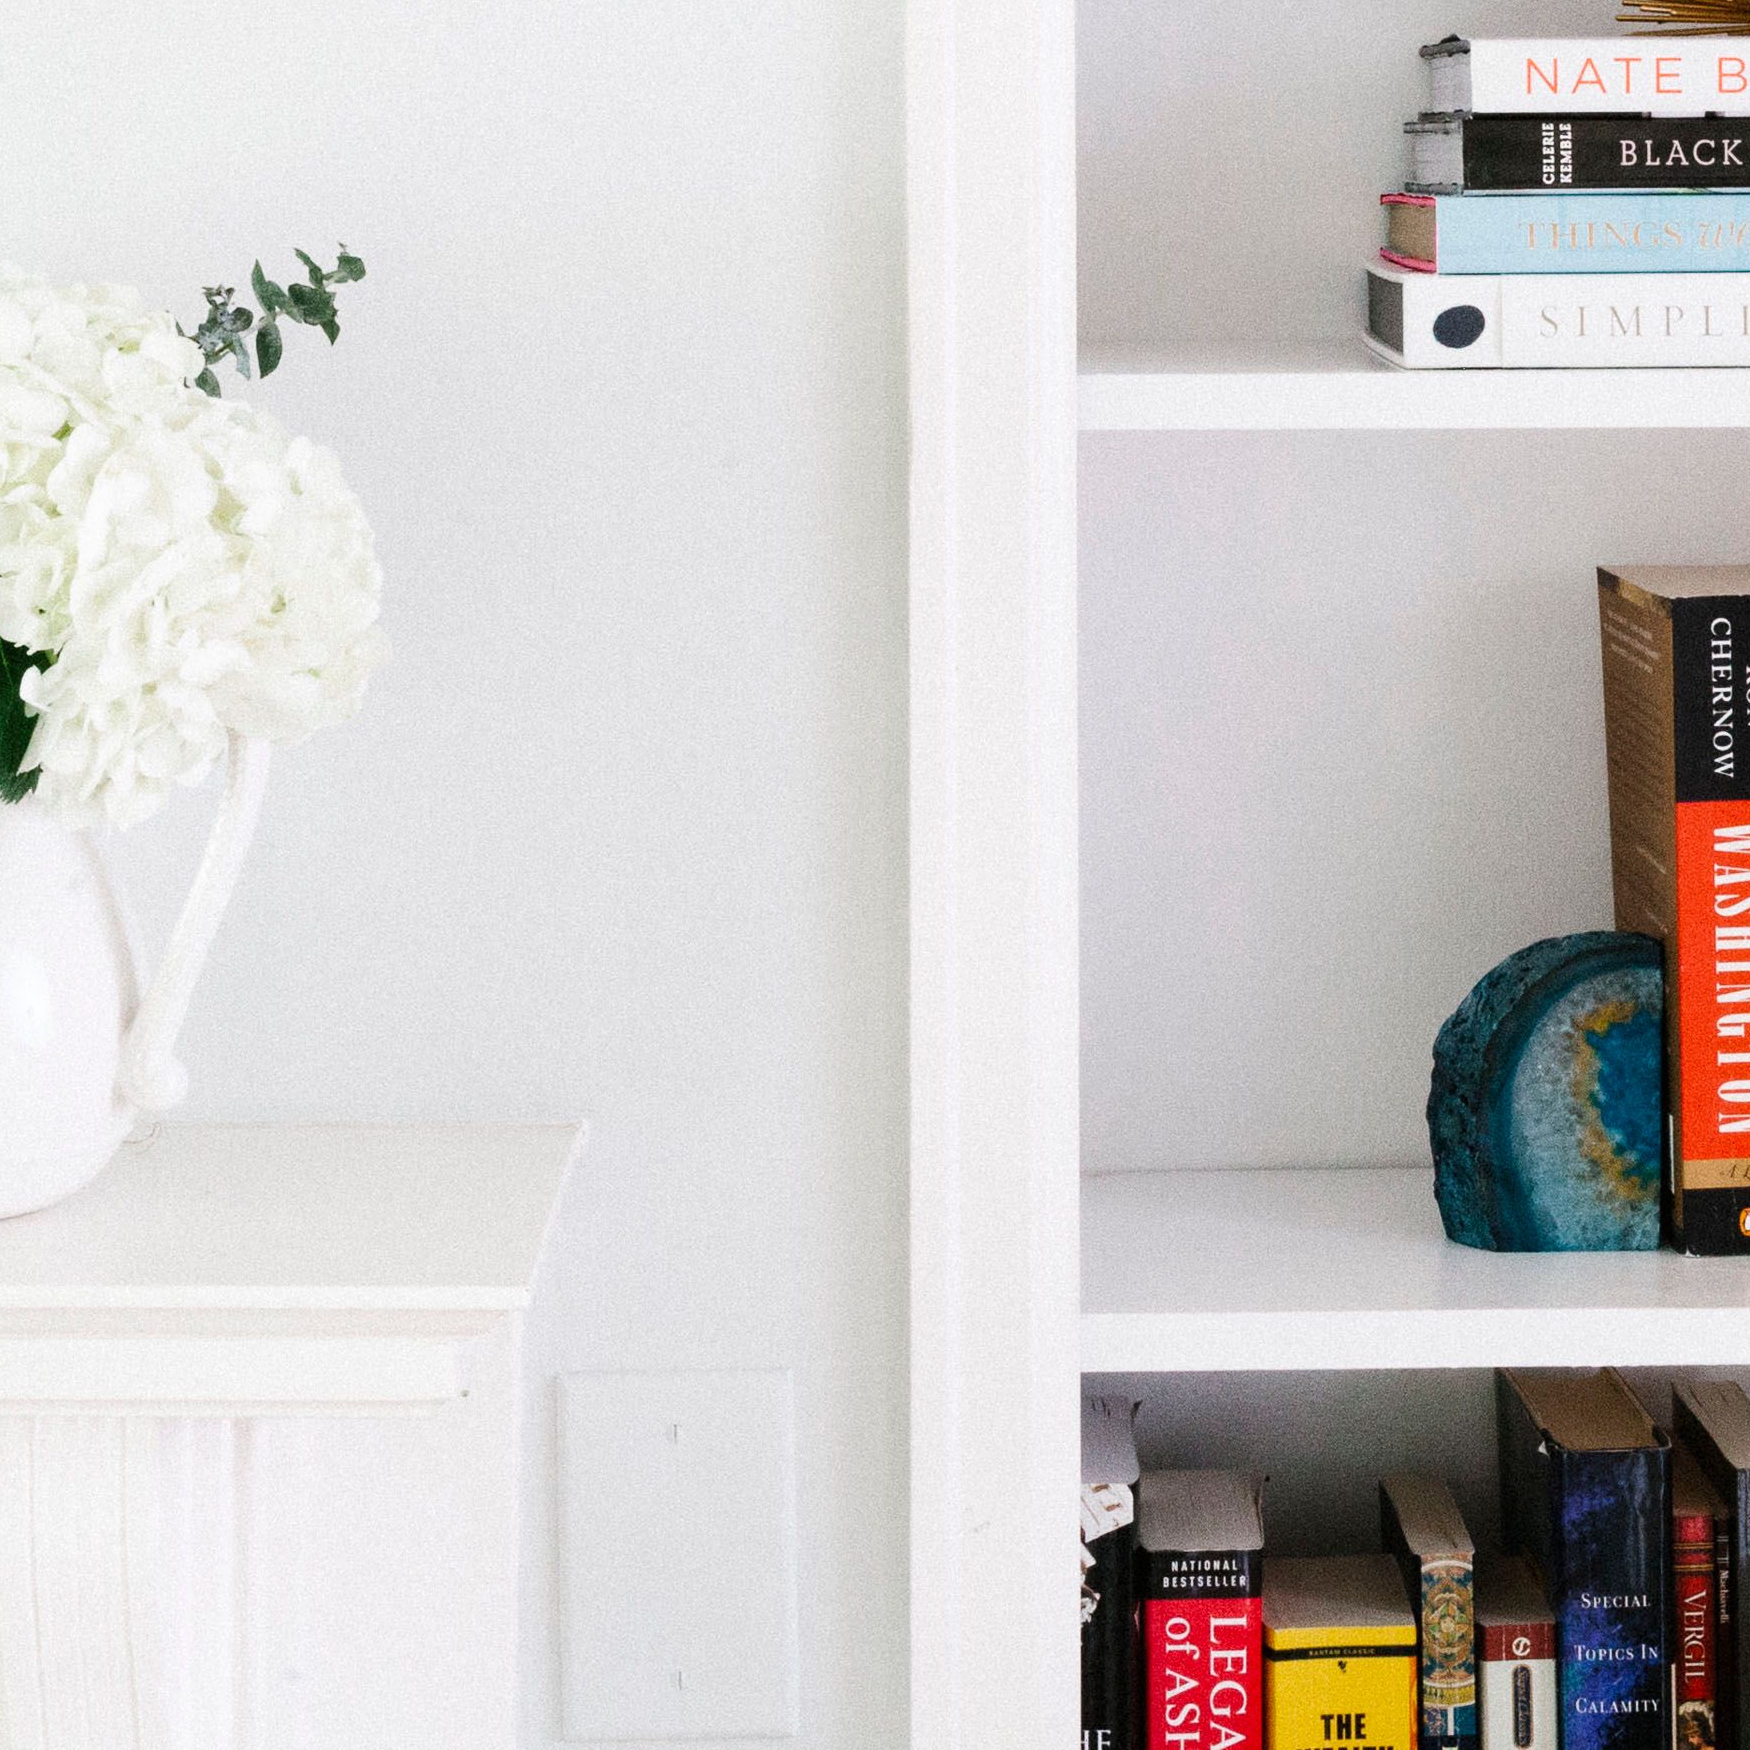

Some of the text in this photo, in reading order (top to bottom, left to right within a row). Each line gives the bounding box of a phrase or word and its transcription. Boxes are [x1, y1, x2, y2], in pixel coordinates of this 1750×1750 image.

[1526, 57, 1684, 95] NATE
[1542, 122, 1555, 184] CELERIE
[1560, 123, 1572, 183] KEMBLE
[1519, 221, 1683, 250] THINGS
[1710, 617, 1734, 778] CHERNOW
[1171, 1560, 1238, 1572] NATIONAL
[1163, 1575, 1247, 1588] BESTSELLER
[1581, 1593, 1650, 1609] SPECIAL
[1683, 1590, 1707, 1683] VERGIL
[1574, 1644, 1634, 1660] TOPICS
[1575, 1698, 1660, 1714] CALAMITY
[1321, 1714, 1366, 1740] THE
